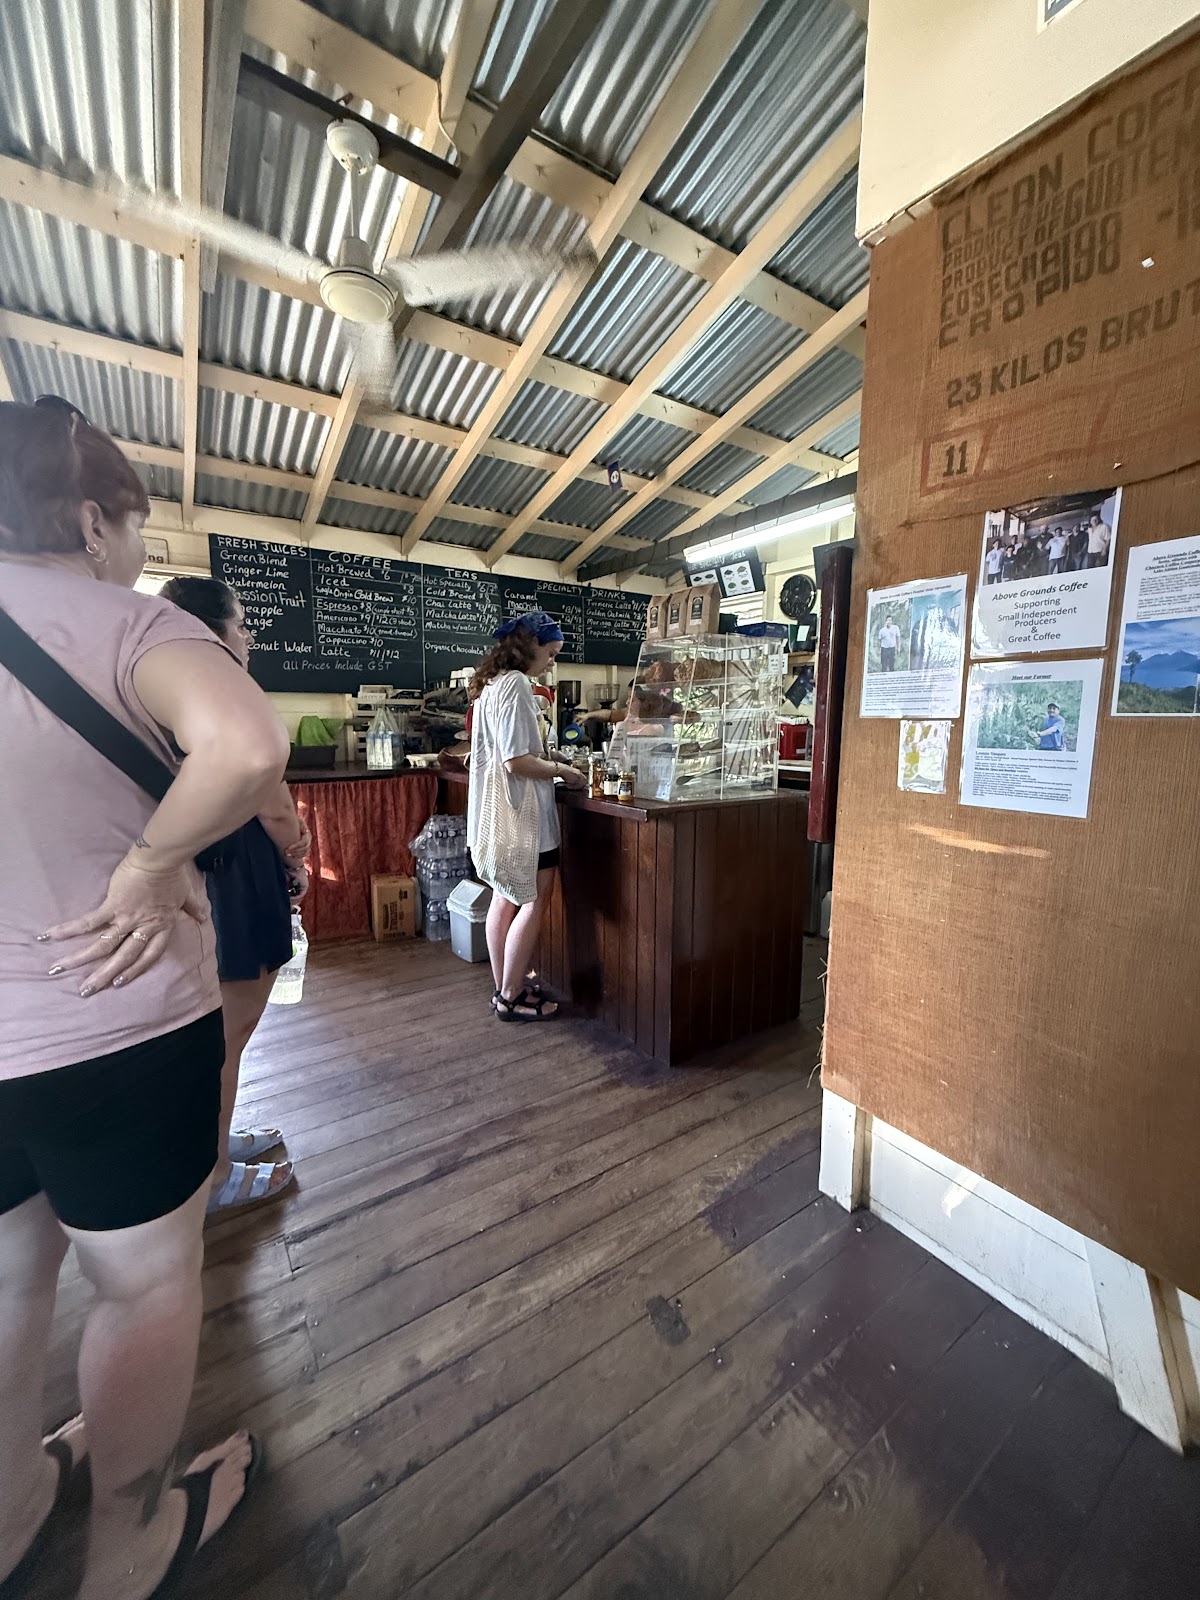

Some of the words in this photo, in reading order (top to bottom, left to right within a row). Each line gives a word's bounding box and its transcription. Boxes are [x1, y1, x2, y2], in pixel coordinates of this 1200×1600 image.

[942, 152, 1064, 253] CLEAN
[941, 234, 1027, 298] PRODUCT
[1034, 216, 1062, 247] OF
[940, 240, 1062, 323] COSECHA
[939, 272, 1062, 350] CROP
[946, 370, 982, 409] 23
[990, 326, 1089, 396] KILOS
[942, 441, 968, 478] 11
[217, 536, 257, 550] FRESH
[261, 542, 307, 557] JUICES
[220, 549, 258, 564] Green
[257, 553, 288, 567] Blend
[328, 551, 392, 570] COFFEE
[223, 562, 262, 578] Ginger
[265, 567, 290, 579] Lime
[317, 562, 335, 573] Hot
[336, 563, 375, 579] Brewed
[445, 568, 478, 580] TEAS
[225, 576, 286, 591] Watermelon
[320, 574, 350, 587] Iced
[423, 575, 438, 585] Hot
[353, 589, 373, 601] Cold
[374, 593, 394, 603] Brew
[426, 587, 446, 597] Cold
[448, 589, 476, 600] Brewed
[504, 588, 539, 601] Caramel
[537, 581, 583, 595] SPECIALTY
[590, 588, 626, 600] DRINKS
[991, 592, 1018, 602] Above
[1020, 585, 1057, 598] Grounds
[1058, 581, 1088, 592] Coffee
[234, 590, 278, 603] assion
[279, 589, 307, 608] Fruit
[316, 598, 359, 612] Espresso
[425, 599, 445, 608] Chai
[448, 600, 472, 610] Latte
[1013, 598, 1061, 610] Supporting
[316, 610, 358, 622] Americano
[425, 609, 457, 620] Matcha
[997, 612, 1020, 622] Small
[1021, 606, 1078, 620] Independent
[245, 617, 274, 631] ange
[317, 623, 362, 635] Macchiato
[425, 621, 451, 629] Matcha
[1014, 617, 1057, 628] Producers
[586, 627, 610, 638] Tropical
[1030, 626, 1038, 634] &
[318, 634, 367, 645] Cappuccino
[1008, 634, 1031, 643] Great
[1033, 632, 1061, 641] Coffee
[247, 640, 280, 651] conut
[284, 640, 313, 653] Water
[320, 645, 351, 657] Latte
[424, 642, 450, 653] Organic
[450, 644, 484, 656] Chocolate
[301, 660, 331, 671] Prices
[335, 660, 363, 671] Include
[367, 660, 393, 671] GST
